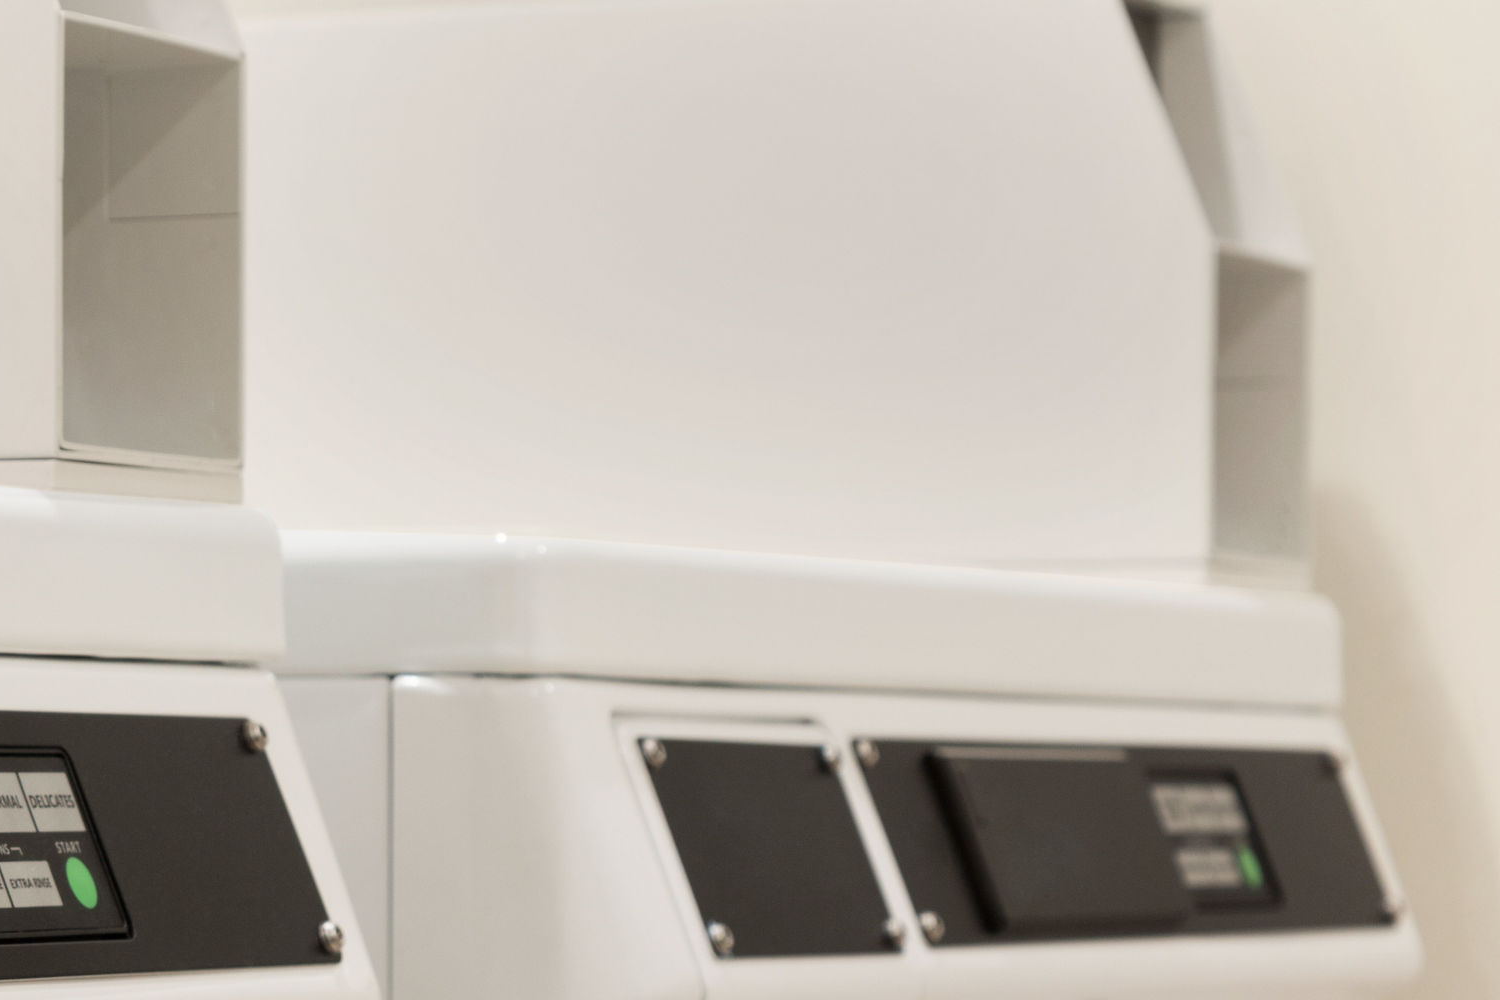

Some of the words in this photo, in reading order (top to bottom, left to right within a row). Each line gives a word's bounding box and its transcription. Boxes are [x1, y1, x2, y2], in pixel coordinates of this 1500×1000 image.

[28, 794, 76, 809] DELICATES
[55, 841, 82, 854] START
[9, 877, 33, 888] EXTRA
